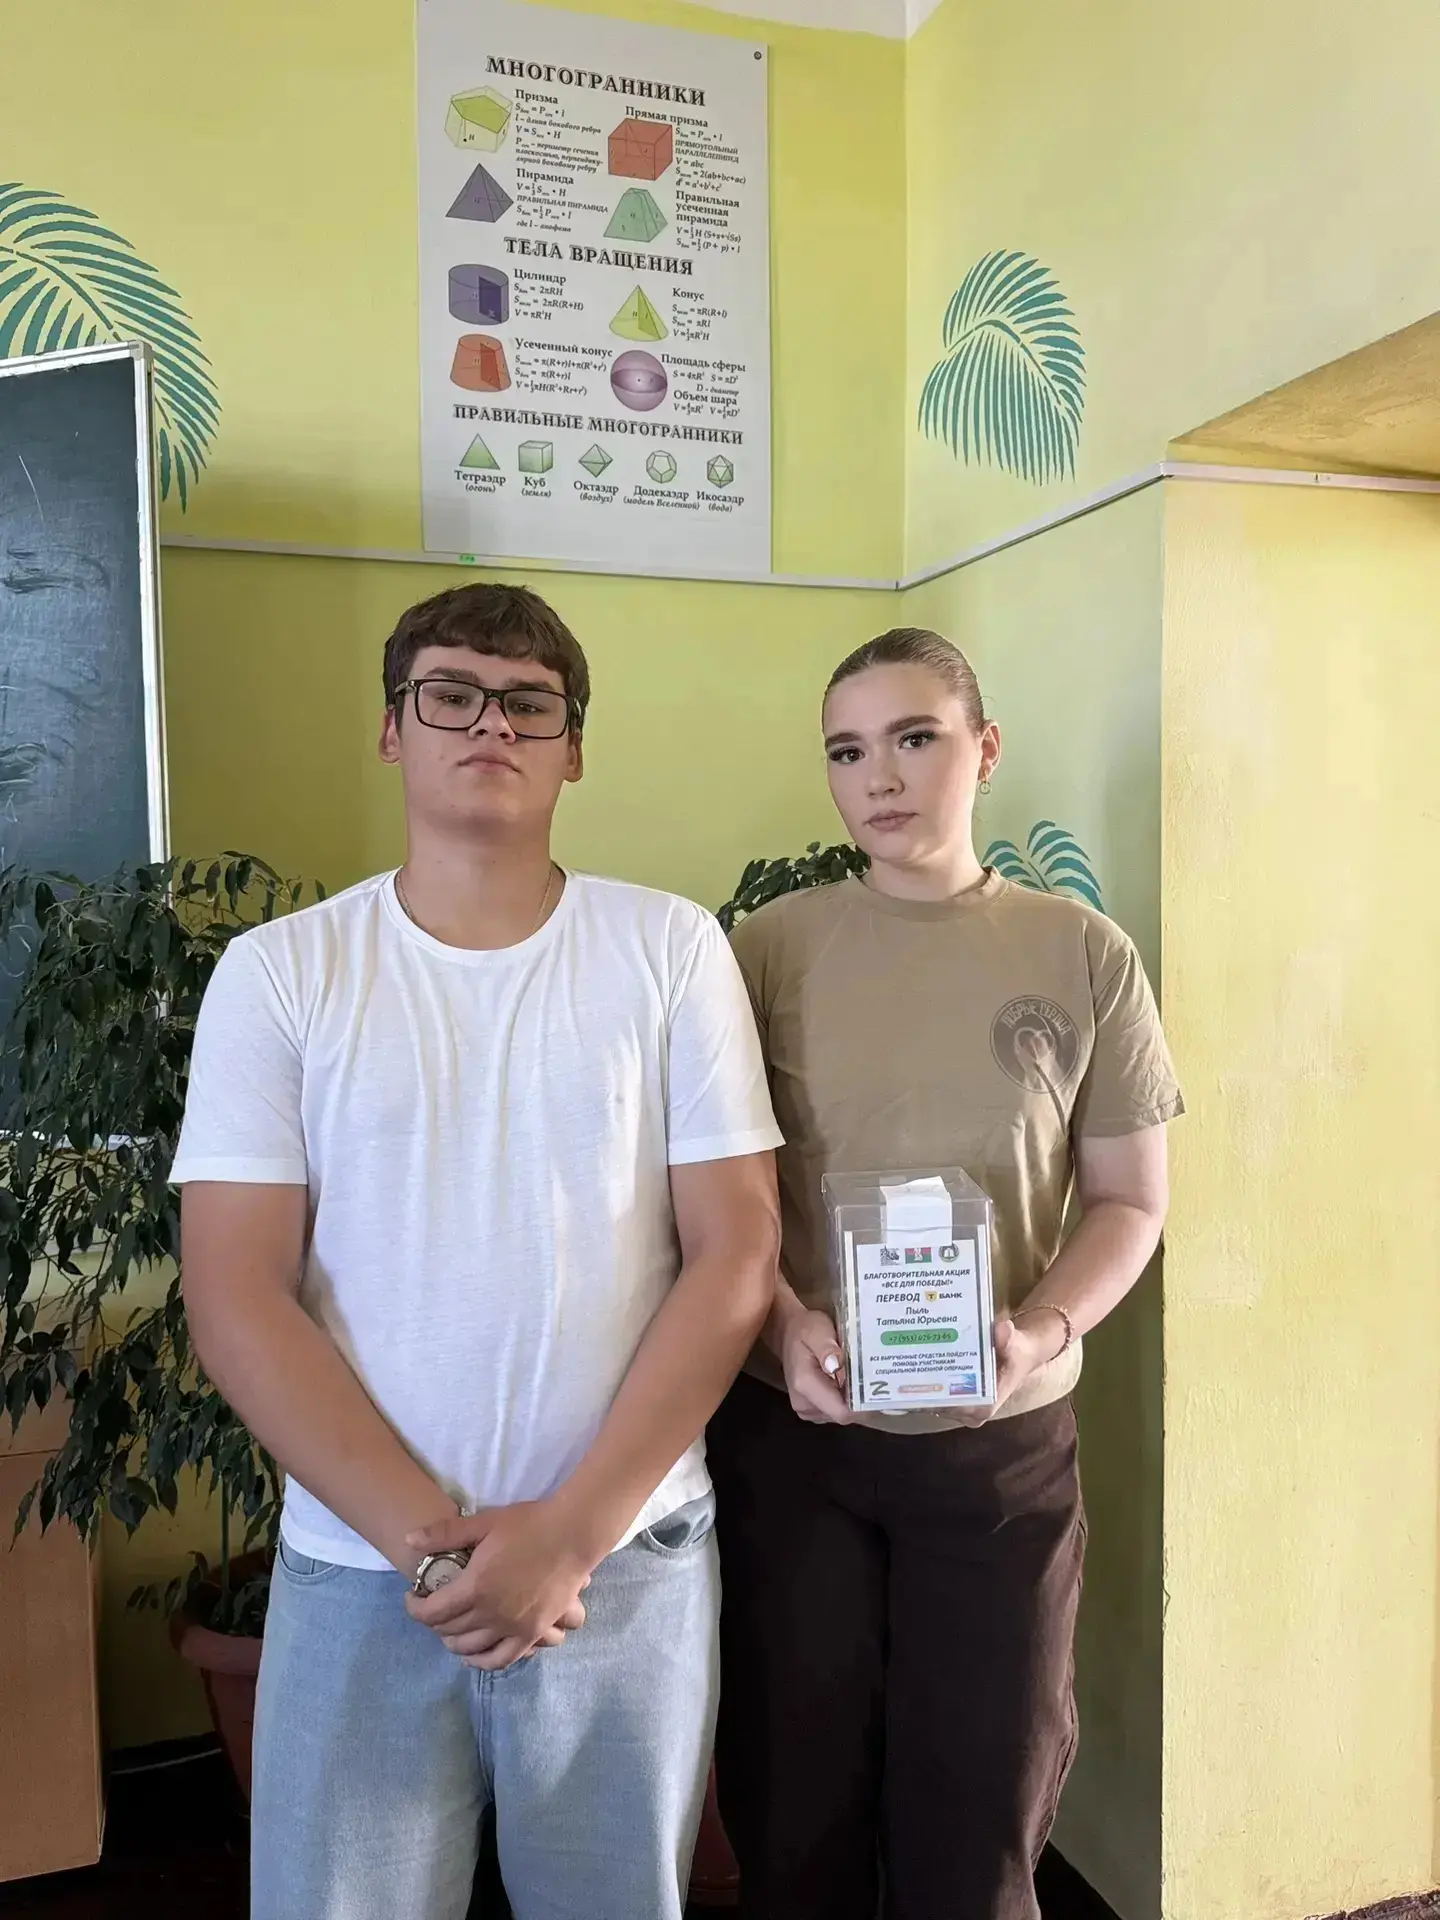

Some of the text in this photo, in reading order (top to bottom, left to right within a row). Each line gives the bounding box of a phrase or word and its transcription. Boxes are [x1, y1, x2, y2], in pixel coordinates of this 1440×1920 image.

[486, 55, 706, 106] МНОГОГРАННИКИ
[515, 89, 558, 104] Призма
[625, 106, 708, 127] Прямая призма
[549, 119, 580, 131] бокового
[581, 125, 601, 134] ребра
[537, 142, 571, 152] периметр
[573, 148, 598, 156] сечения
[675, 140, 738, 154] ПРЯМОУГОЛЬНЫЙ
[516, 149, 603, 166] плоскостью, перпендику-
[675, 148, 739, 163] ПАРАЛЛЕЛЕПИПЕД
[516, 156, 596, 173] лярной боковому ребру
[517, 168, 574, 184] Пирамида
[517, 195, 608, 212] ПРАВИЛЬНАЯ ПИРАМИДА
[676, 190, 739, 207] Правильная
[676, 203, 728, 216] усеченная
[540, 224, 571, 232] апофема
[676, 214, 728, 227] пирамида
[503, 237, 693, 275] ТЕЛА ВРАЩЕНИЯ
[514, 269, 566, 284] Цилиндр
[672, 288, 704, 302] Конус
[515, 337, 613, 359] Усеченный конус
[661, 354, 746, 373] Площадь сферы
[674, 390, 737, 407] Объем шара
[710, 387, 739, 396] диаметр
[454, 404, 743, 445] ПРАВИЛЬНЫЕ МНОГОГРАННИКИ
[454, 470, 506, 485] Тетраэдр
[524, 476, 546, 489] Куб
[465, 483, 496, 493] (огонь)
[522, 488, 552, 498] (земля)
[573, 480, 619, 495] Октаэдр
[634, 485, 689, 501] Додекаэдр
[579, 492, 614, 504] (воздух)
[623, 496, 700, 510] (модель Вселенной)
[696, 491, 744, 506] Икосаэдр
[708, 503, 732, 513] (вода)
[864, 1269, 970, 1280] БЛАГОТВОРИТЕЛЬНАЯ АКЦИЯ
[876, 1293, 920, 1302] ПЕРЕВОД
[906, 1307, 929, 1315] Пыль
[877, 1316, 957, 1326] Татьяна Юрьевна
[870, 1381, 889, 1396] Z
